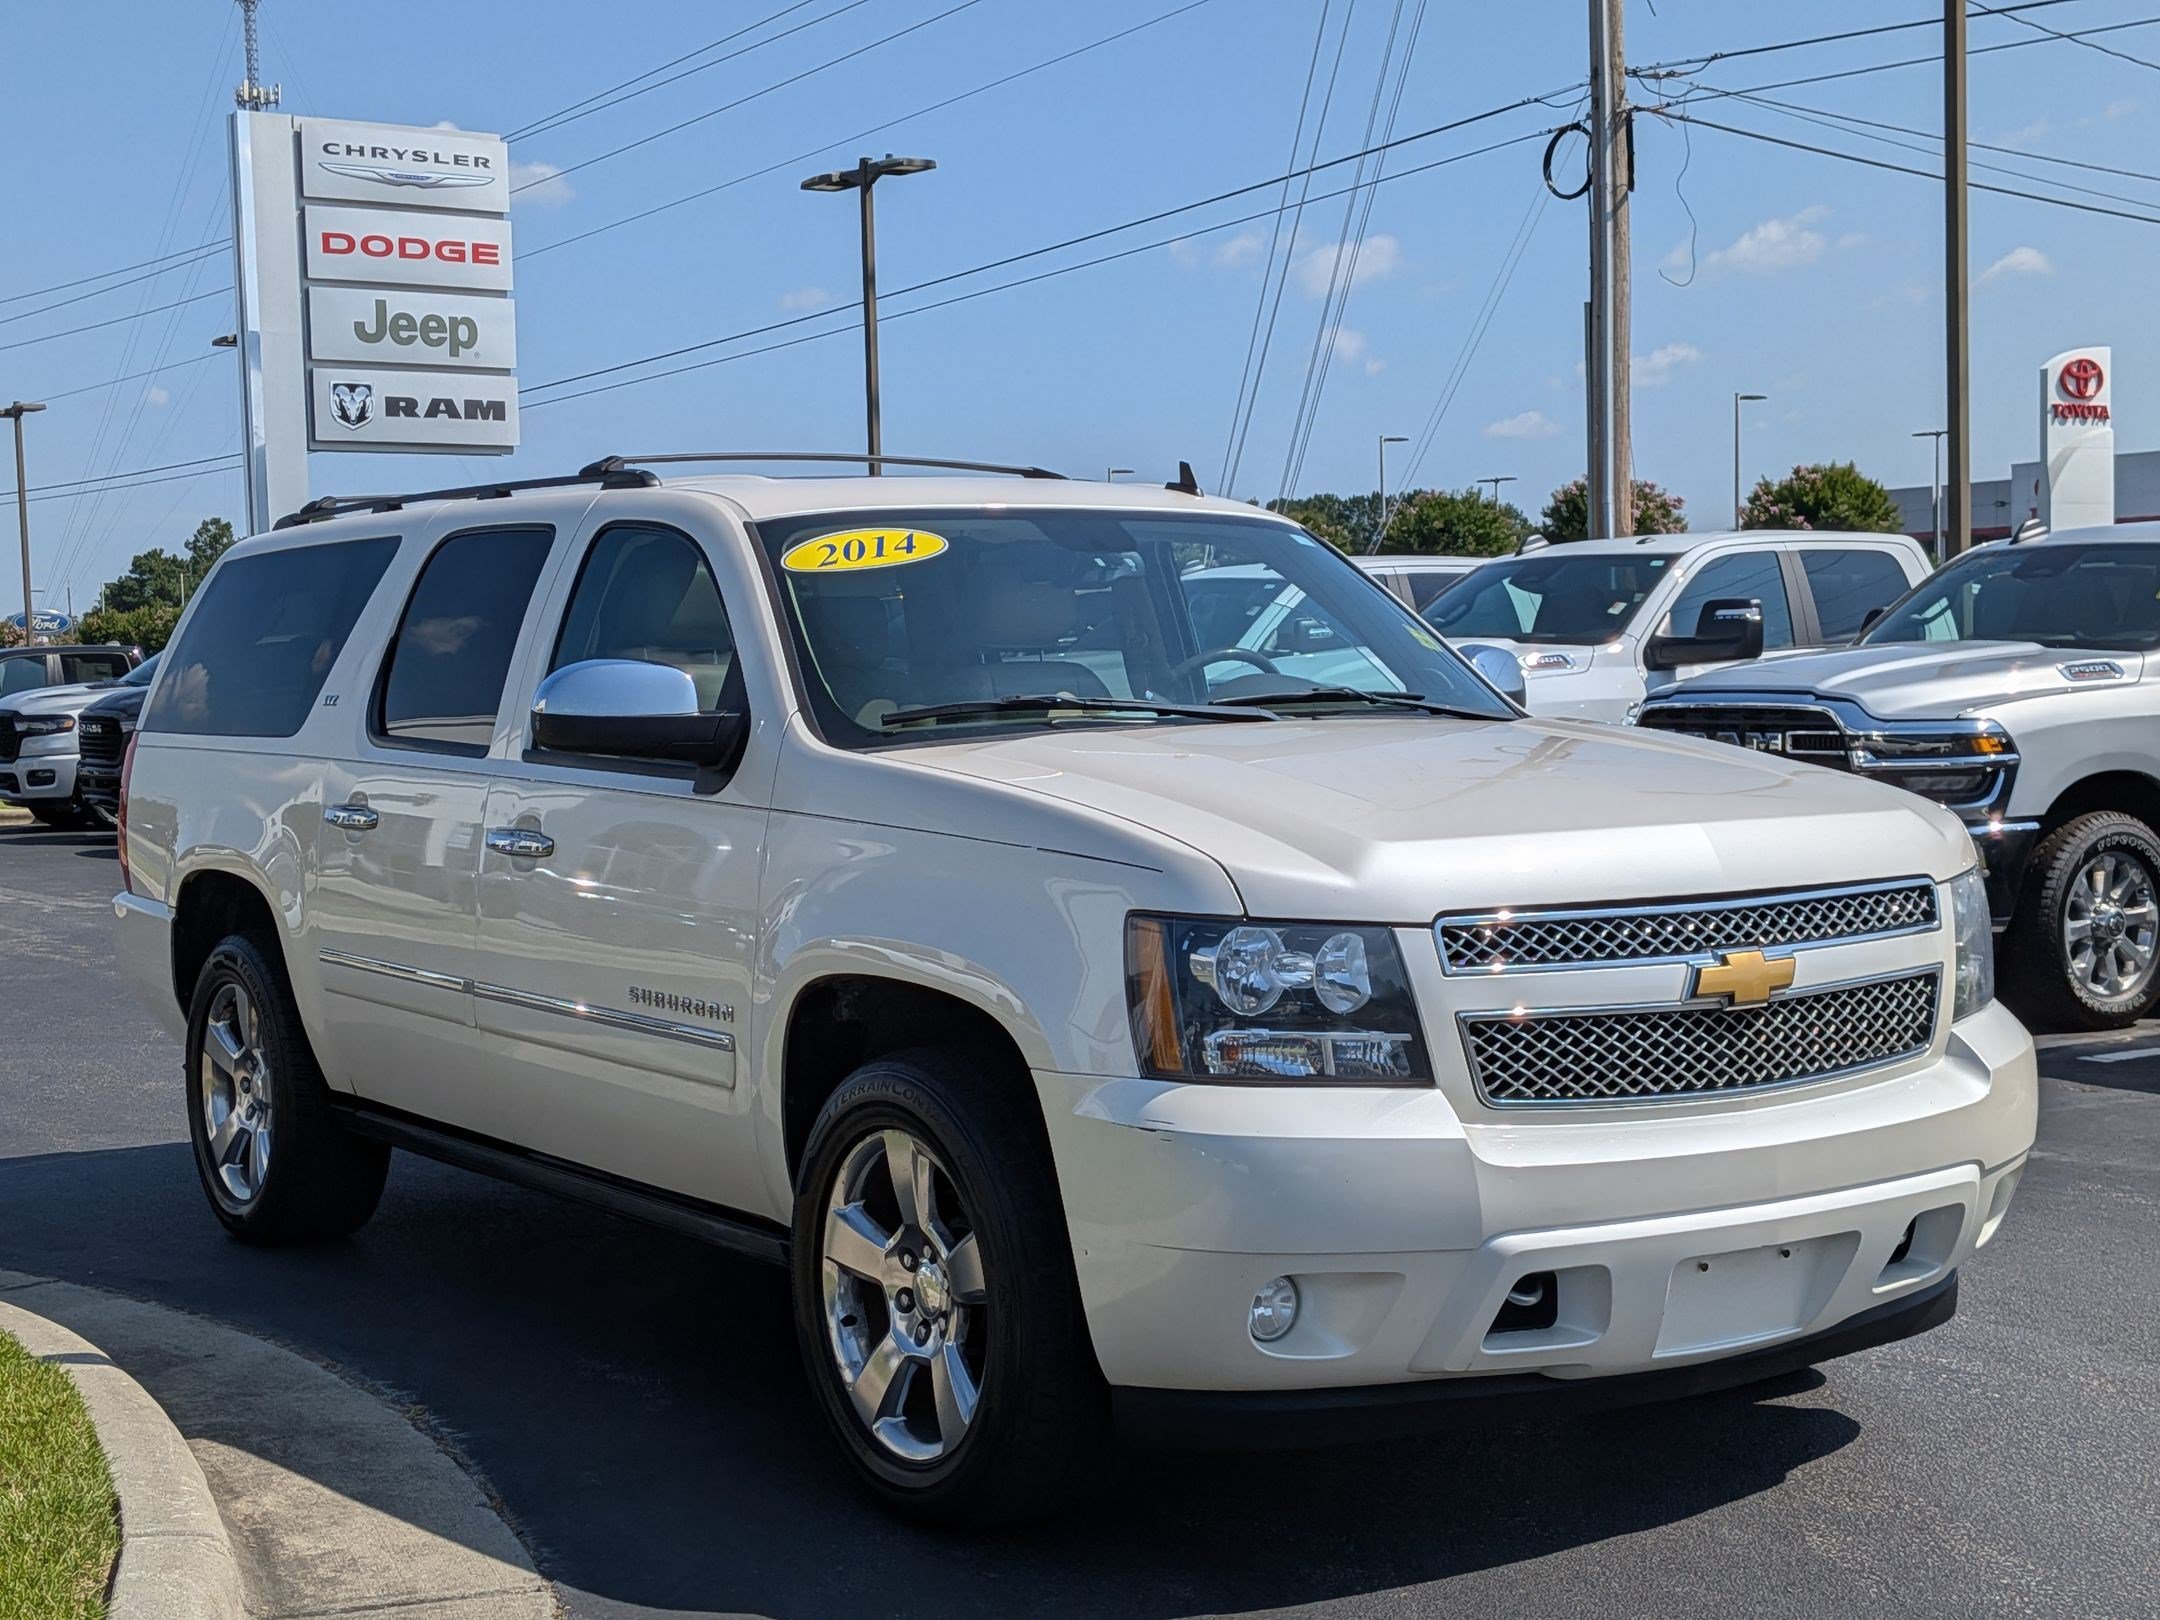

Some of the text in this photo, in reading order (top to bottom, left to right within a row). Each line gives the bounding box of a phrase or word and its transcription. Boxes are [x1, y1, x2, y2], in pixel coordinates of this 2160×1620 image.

[322, 142, 491, 169] CHRYSLER
[321, 232, 500, 265] DODGE
[353, 299, 478, 357] Jeep
[384, 396, 506, 421] RAM
[2051, 404, 2110, 420] TOYOTA
[816, 533, 916, 568] 2014
[31, 615, 60, 630] Ford
[628, 985, 735, 1023] SUBURBAN
